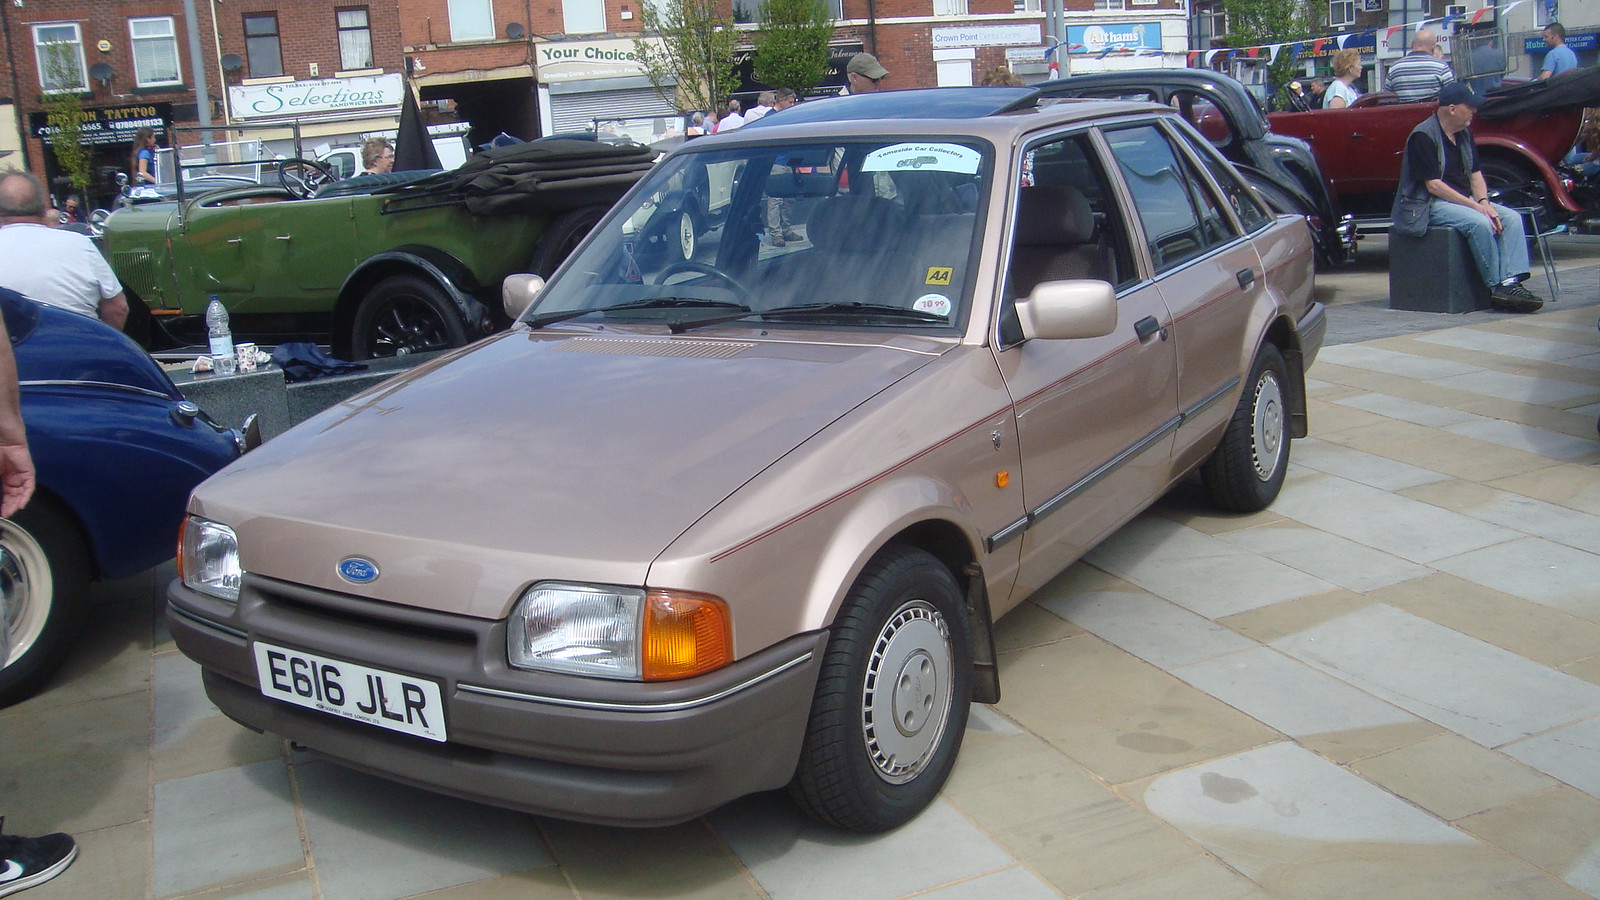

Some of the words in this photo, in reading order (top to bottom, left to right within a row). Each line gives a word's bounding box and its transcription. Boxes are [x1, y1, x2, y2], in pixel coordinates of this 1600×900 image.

[935, 34, 959, 42] Crown
[960, 33, 978, 41] Point
[1091, 31, 1139, 43] Althams
[542, 47, 580, 61] Your
[584, 46, 635, 61] Choice
[252, 84, 384, 114] Selections
[104, 105, 156, 120] TATTOO
[877, 146, 913, 158] Tameside
[928, 146, 963, 158] Collectors
[929, 270, 949, 281] AA
[345, 561, 370, 577] Ford
[266, 650, 346, 707] E616
[356, 674, 430, 729] JLR
